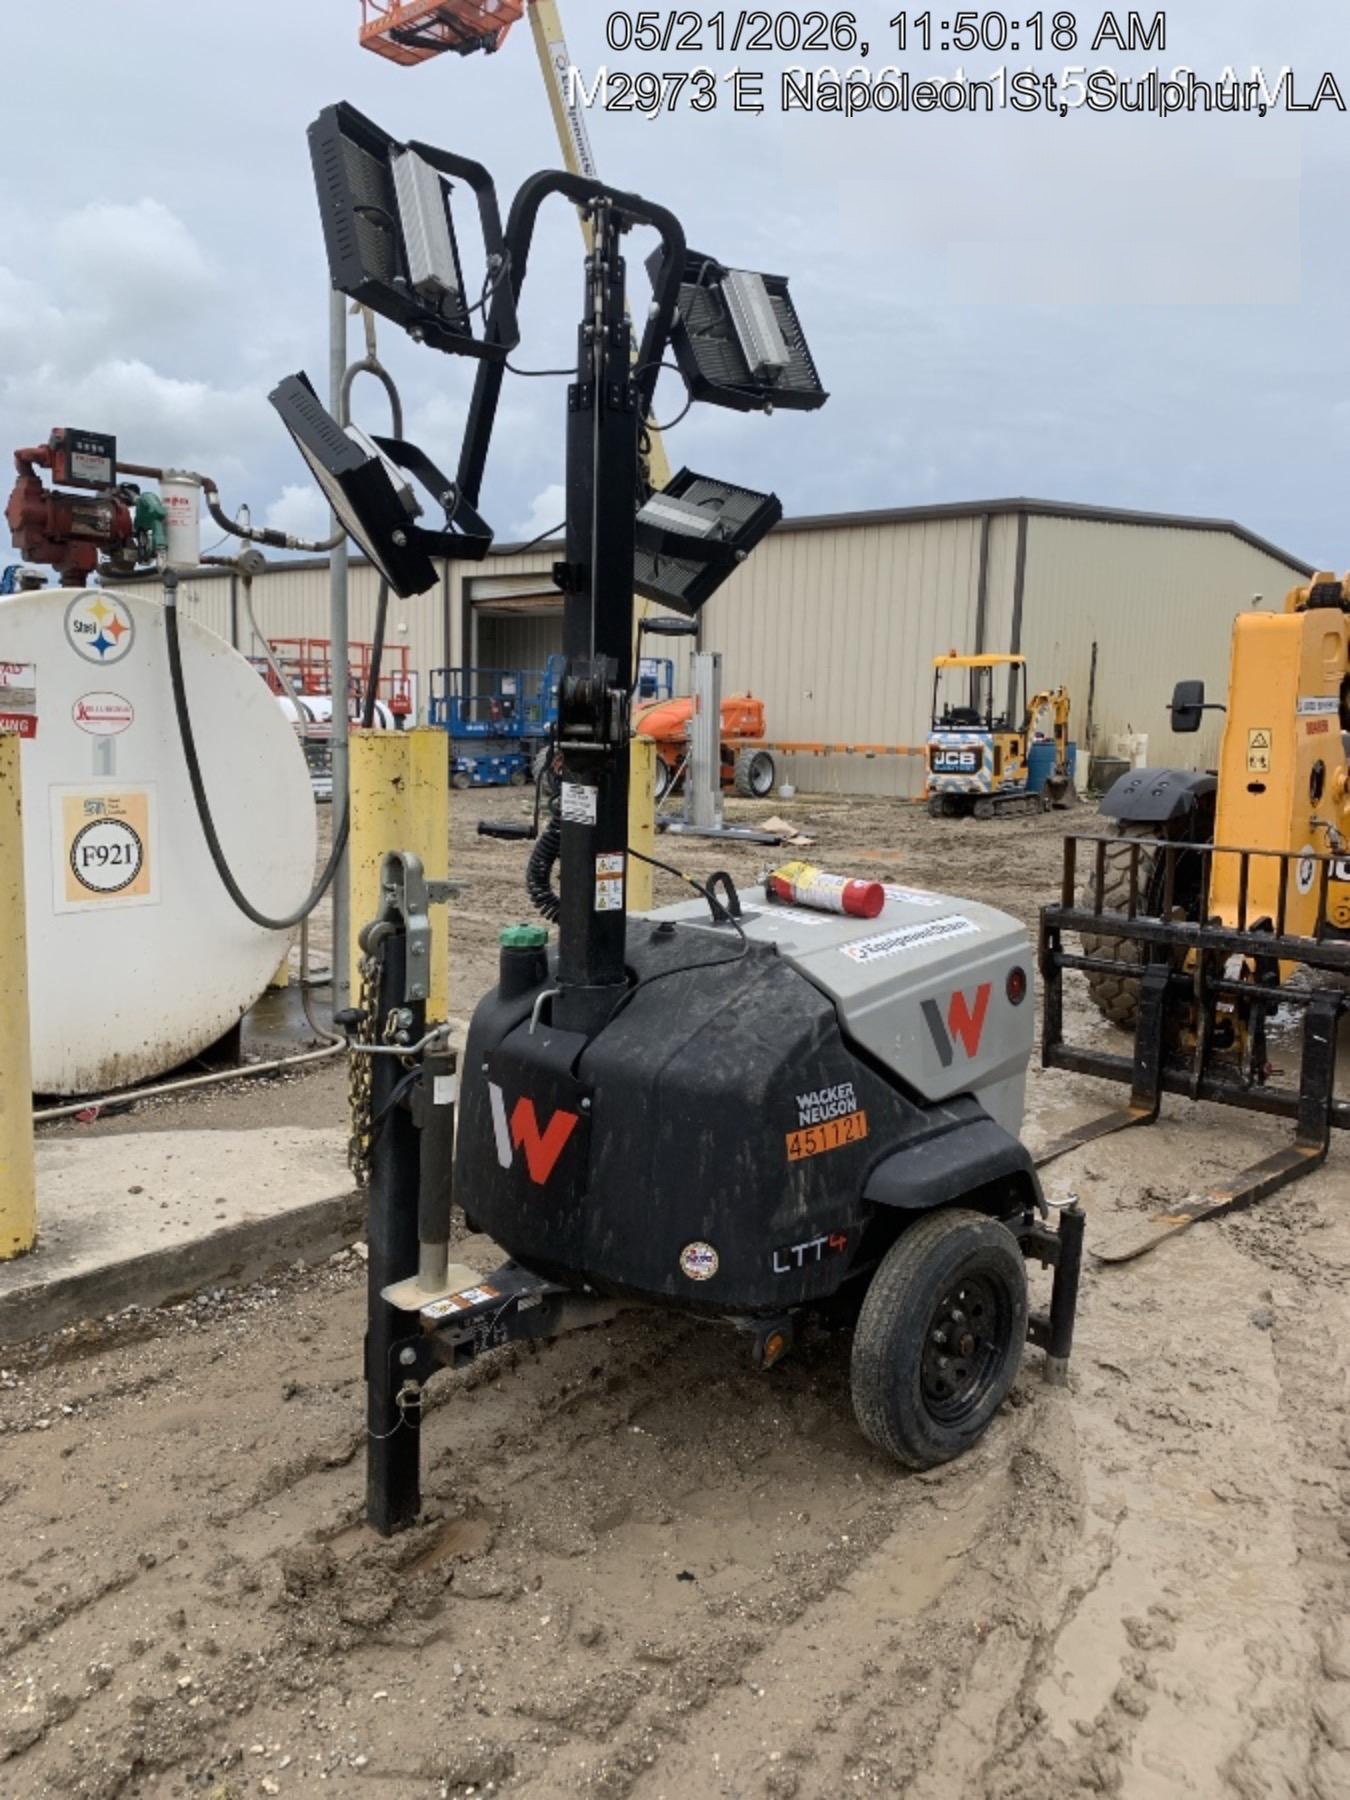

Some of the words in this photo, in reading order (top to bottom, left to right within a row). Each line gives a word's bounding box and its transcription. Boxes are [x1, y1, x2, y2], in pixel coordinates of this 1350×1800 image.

[934, 752, 976, 765] JCB
[82, 843, 134, 867] F921
[795, 1082, 855, 1110] WACKER
[799, 1096, 857, 1127] NEUSON
[789, 1114, 863, 1157] 451121
